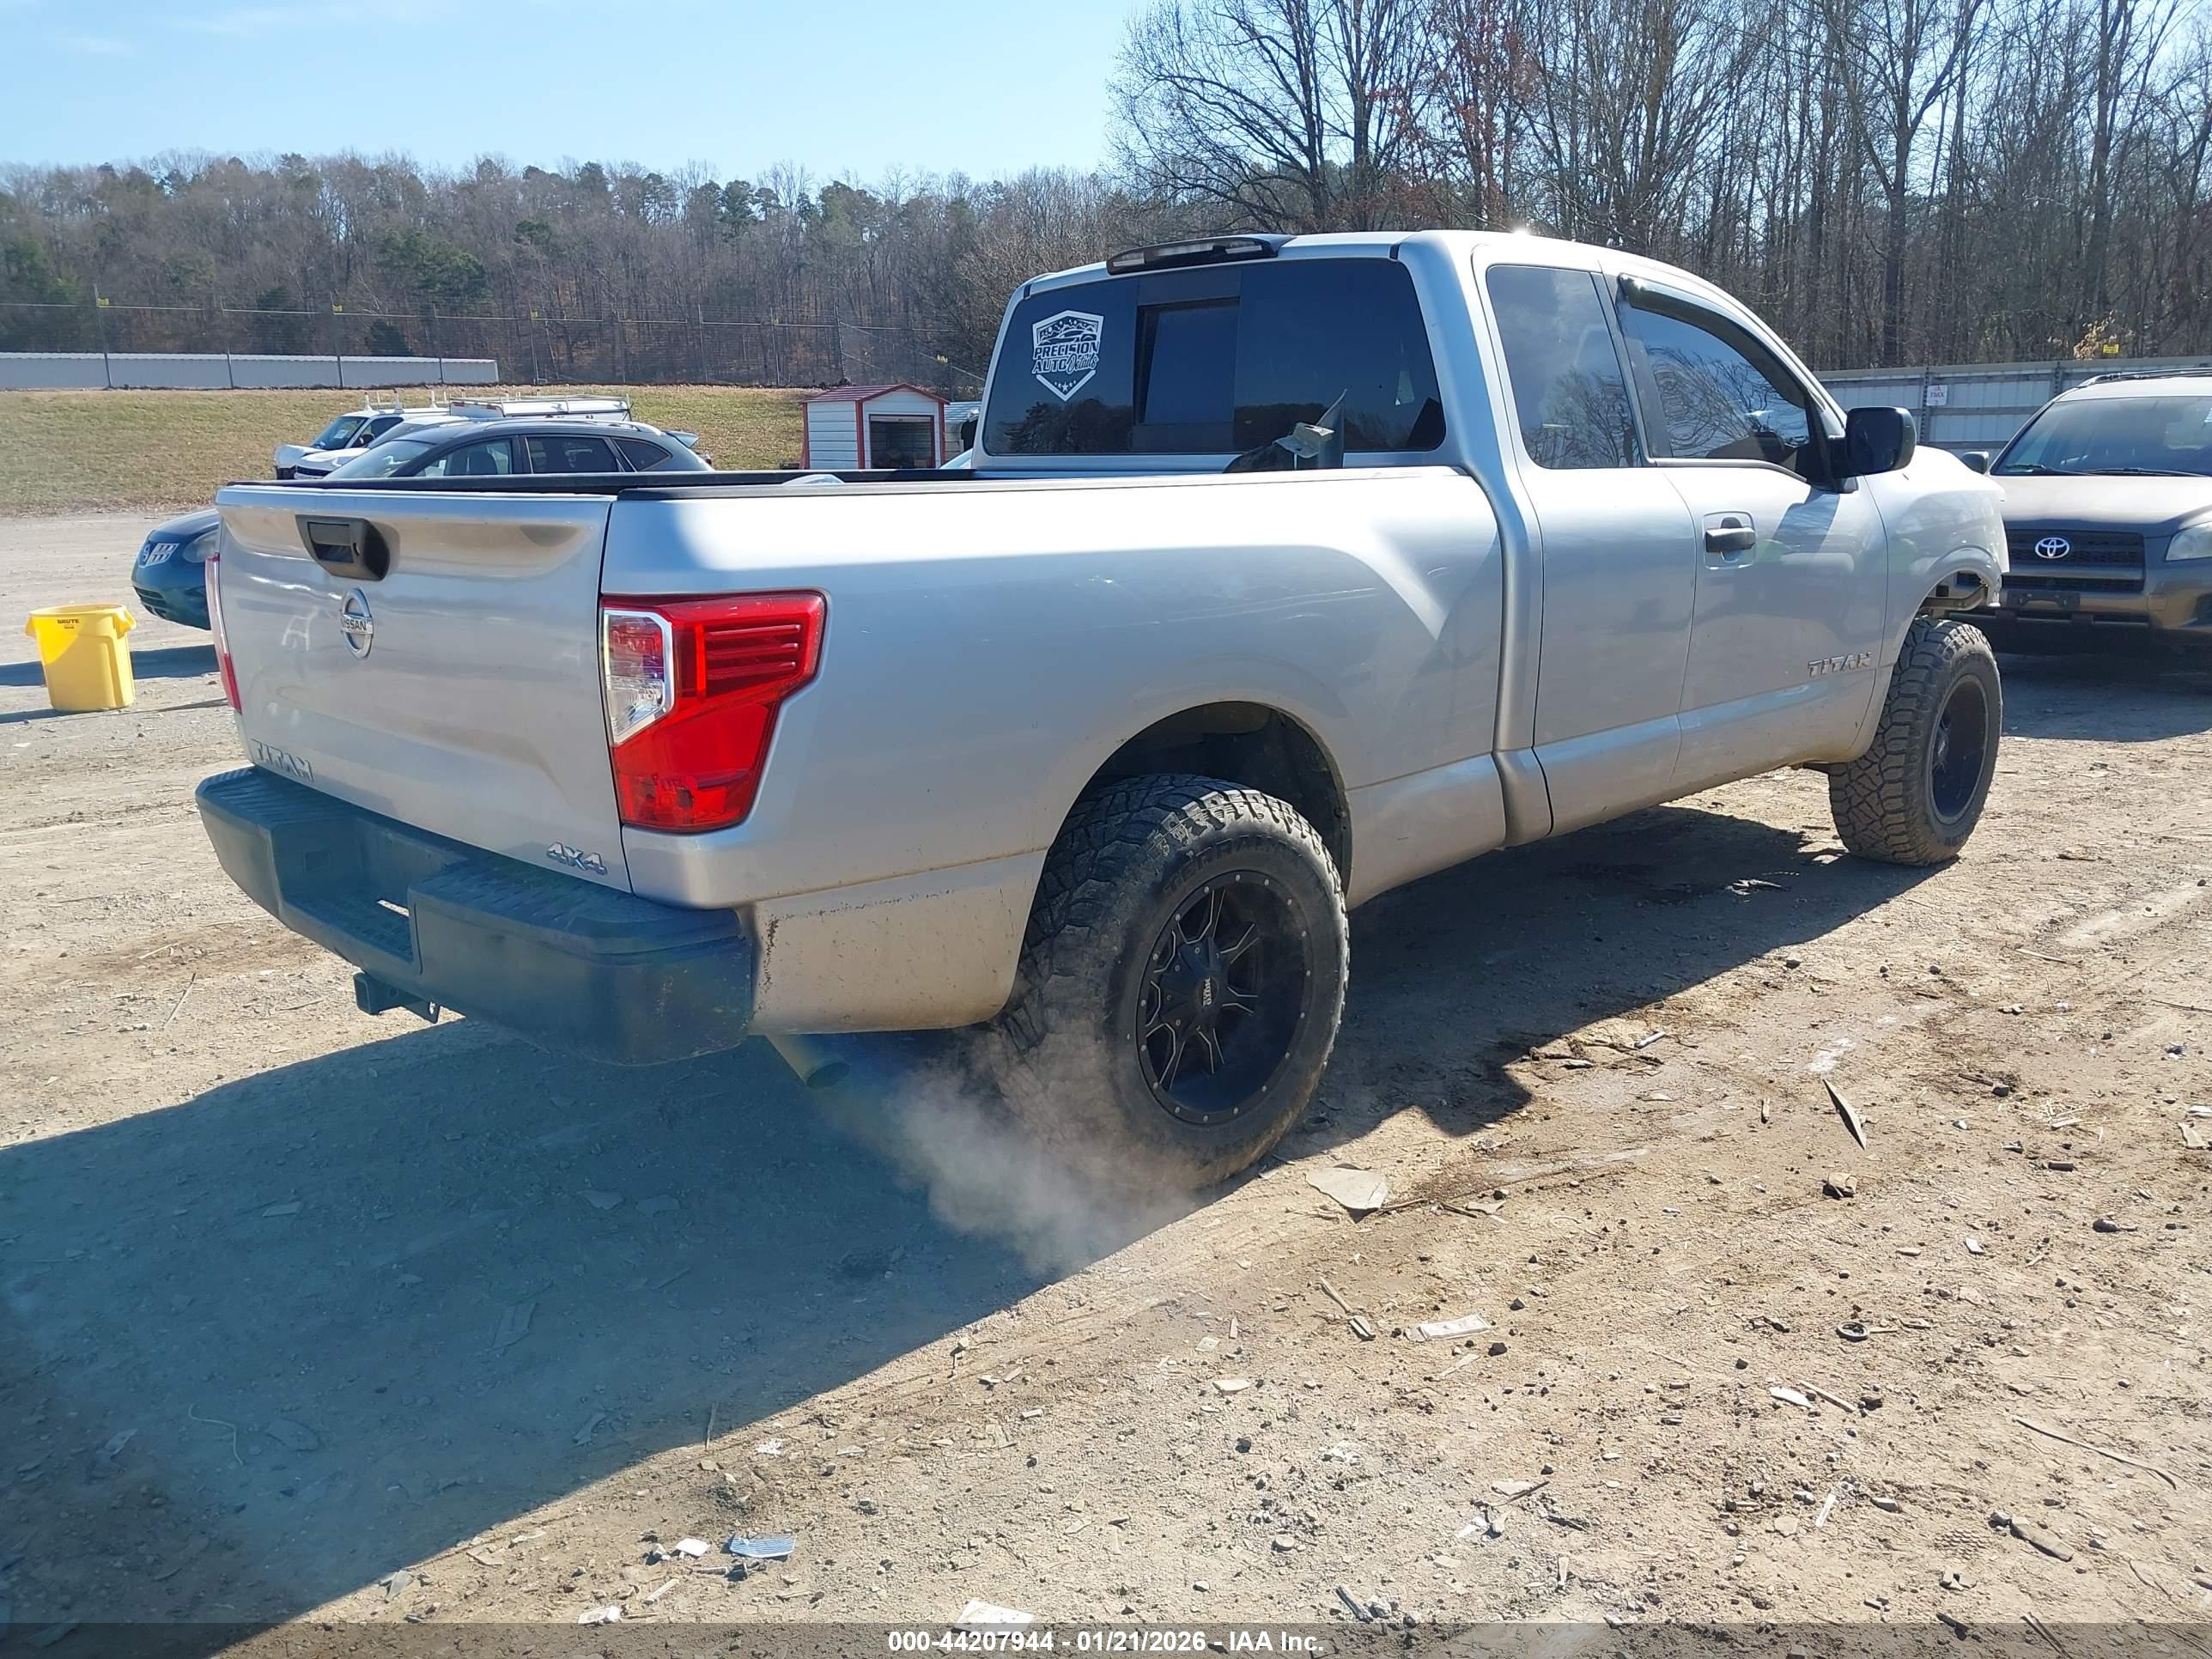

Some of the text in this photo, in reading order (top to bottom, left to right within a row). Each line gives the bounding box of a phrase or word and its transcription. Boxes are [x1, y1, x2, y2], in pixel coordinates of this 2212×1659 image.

[1033, 341, 1099, 360] PRECISION
[1032, 357, 1067, 374] AUTO
[1808, 652, 1872, 678] TITAN
